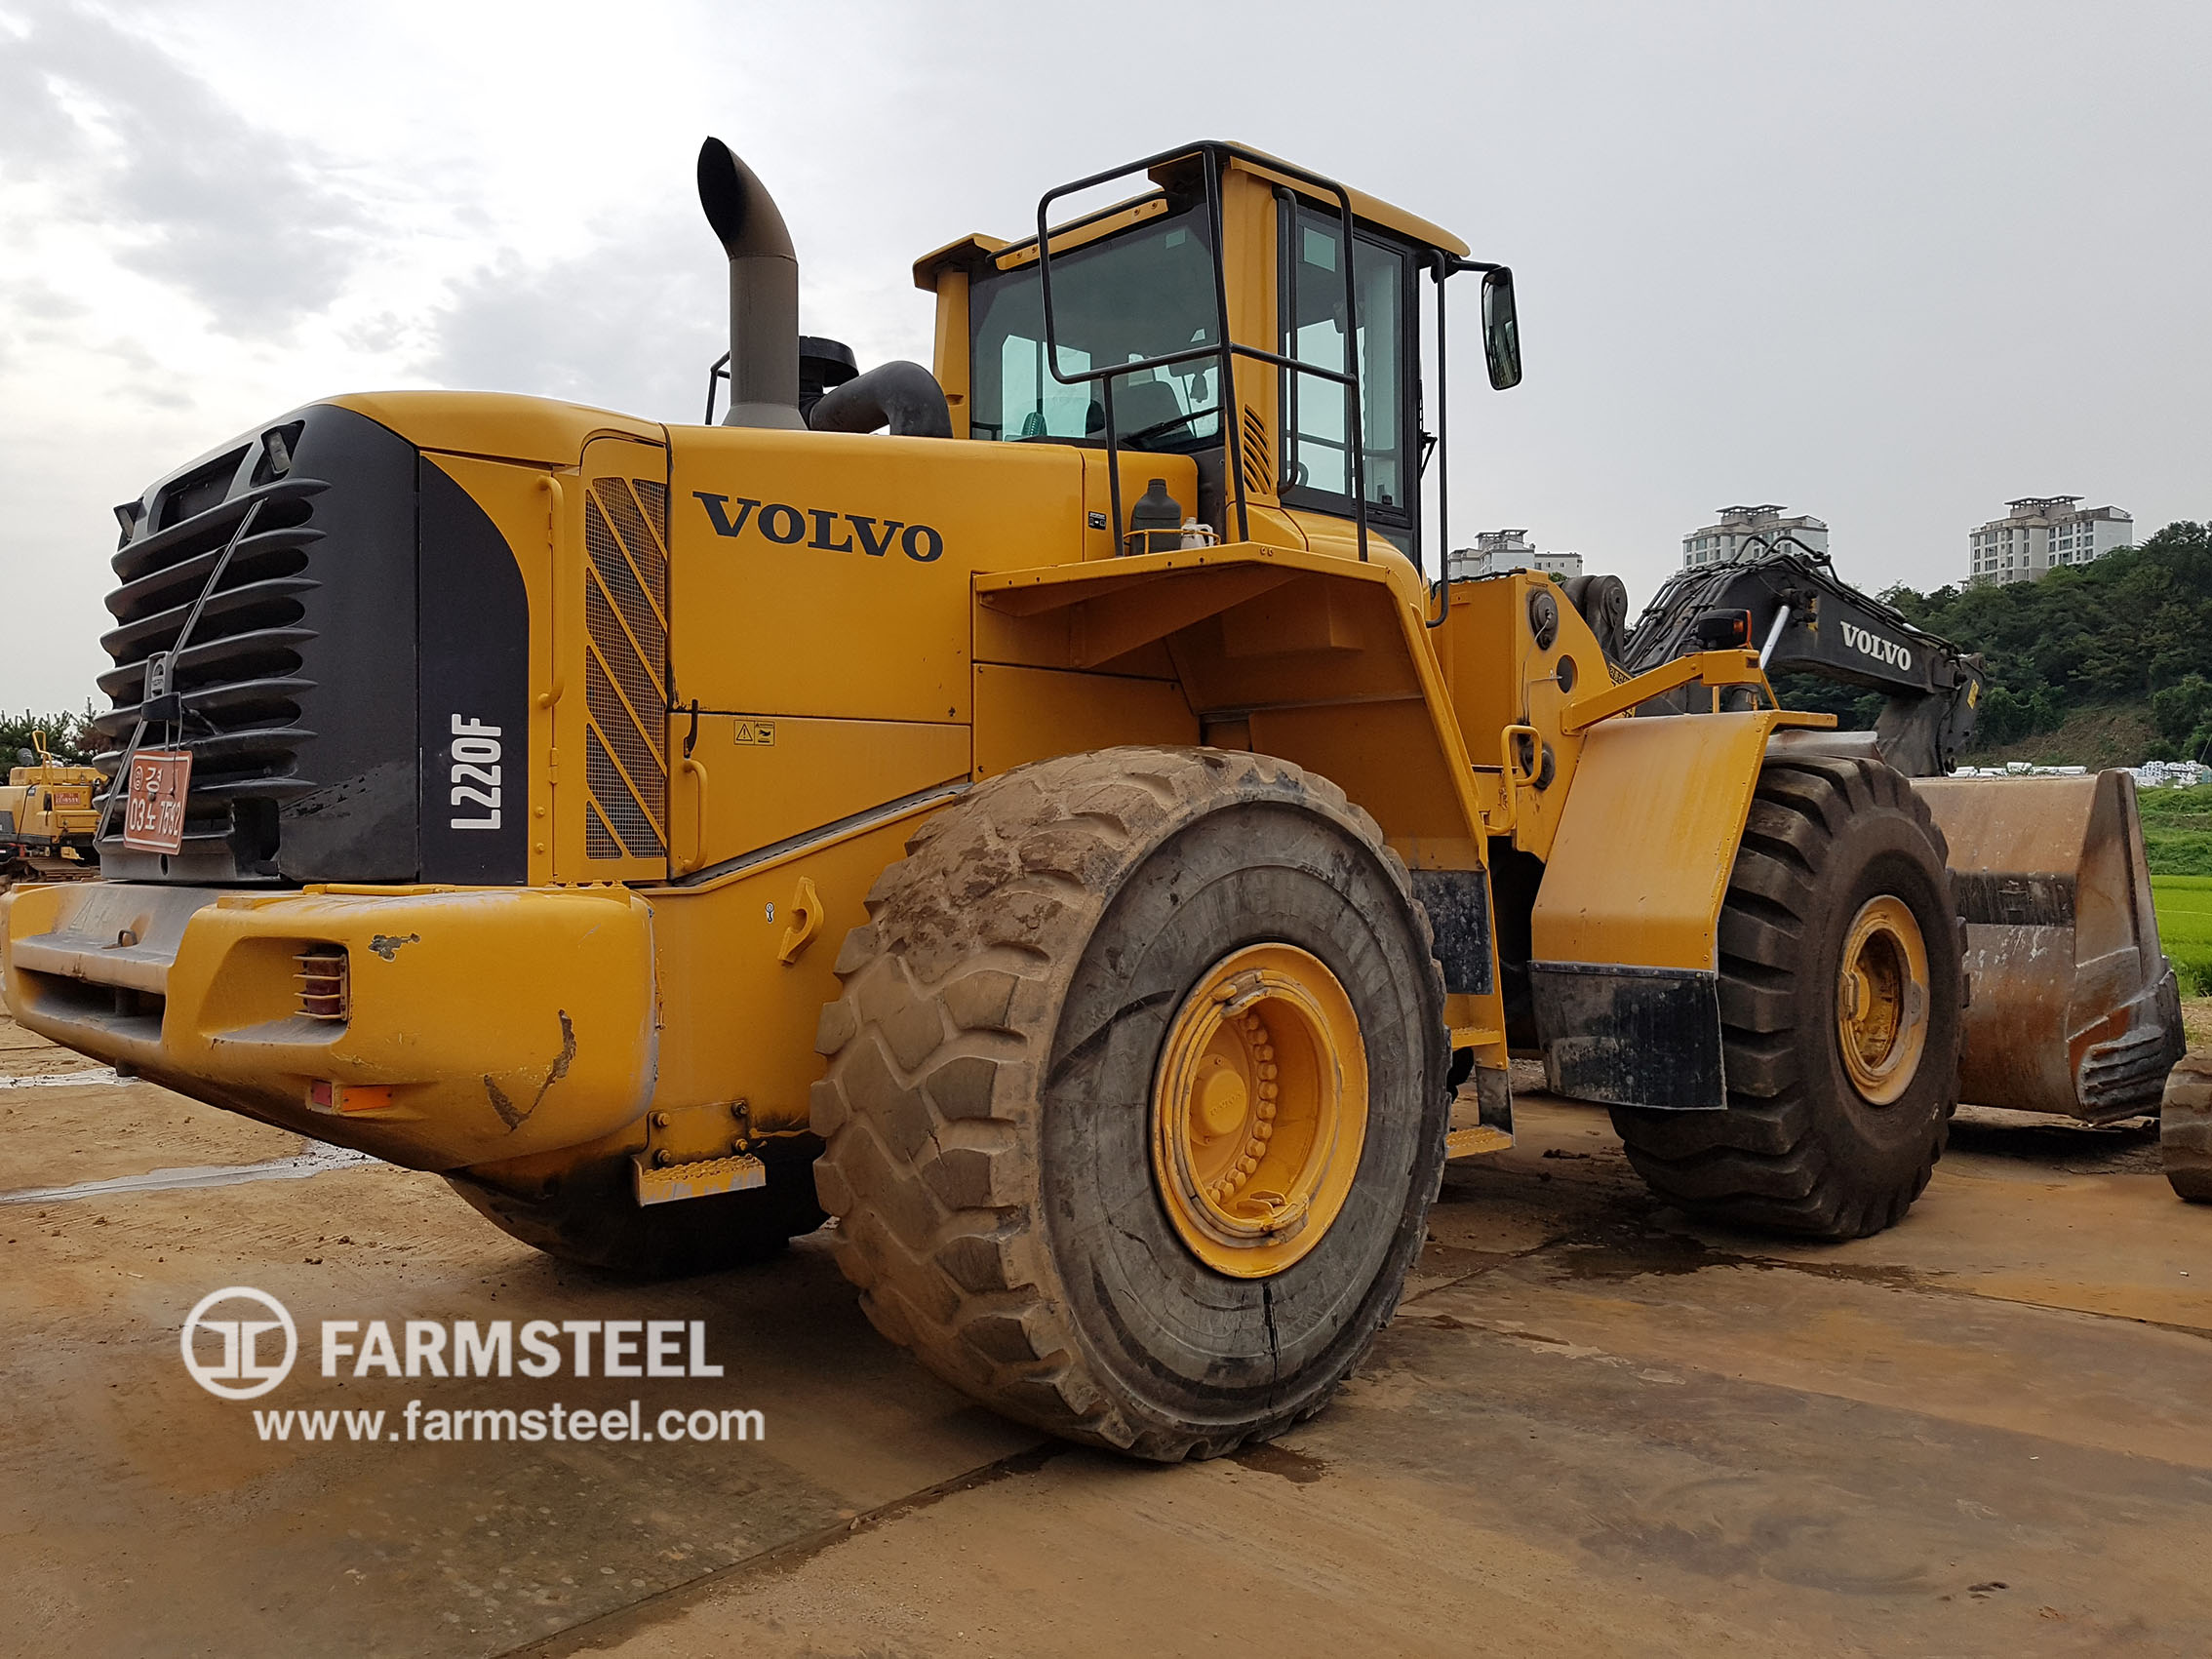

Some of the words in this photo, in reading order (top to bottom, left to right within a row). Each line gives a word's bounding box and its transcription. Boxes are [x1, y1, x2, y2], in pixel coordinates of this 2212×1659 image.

[691, 491, 944, 563] VOLVO
[1839, 620, 1912, 671] VOLVO
[451, 713, 501, 829] L220F
